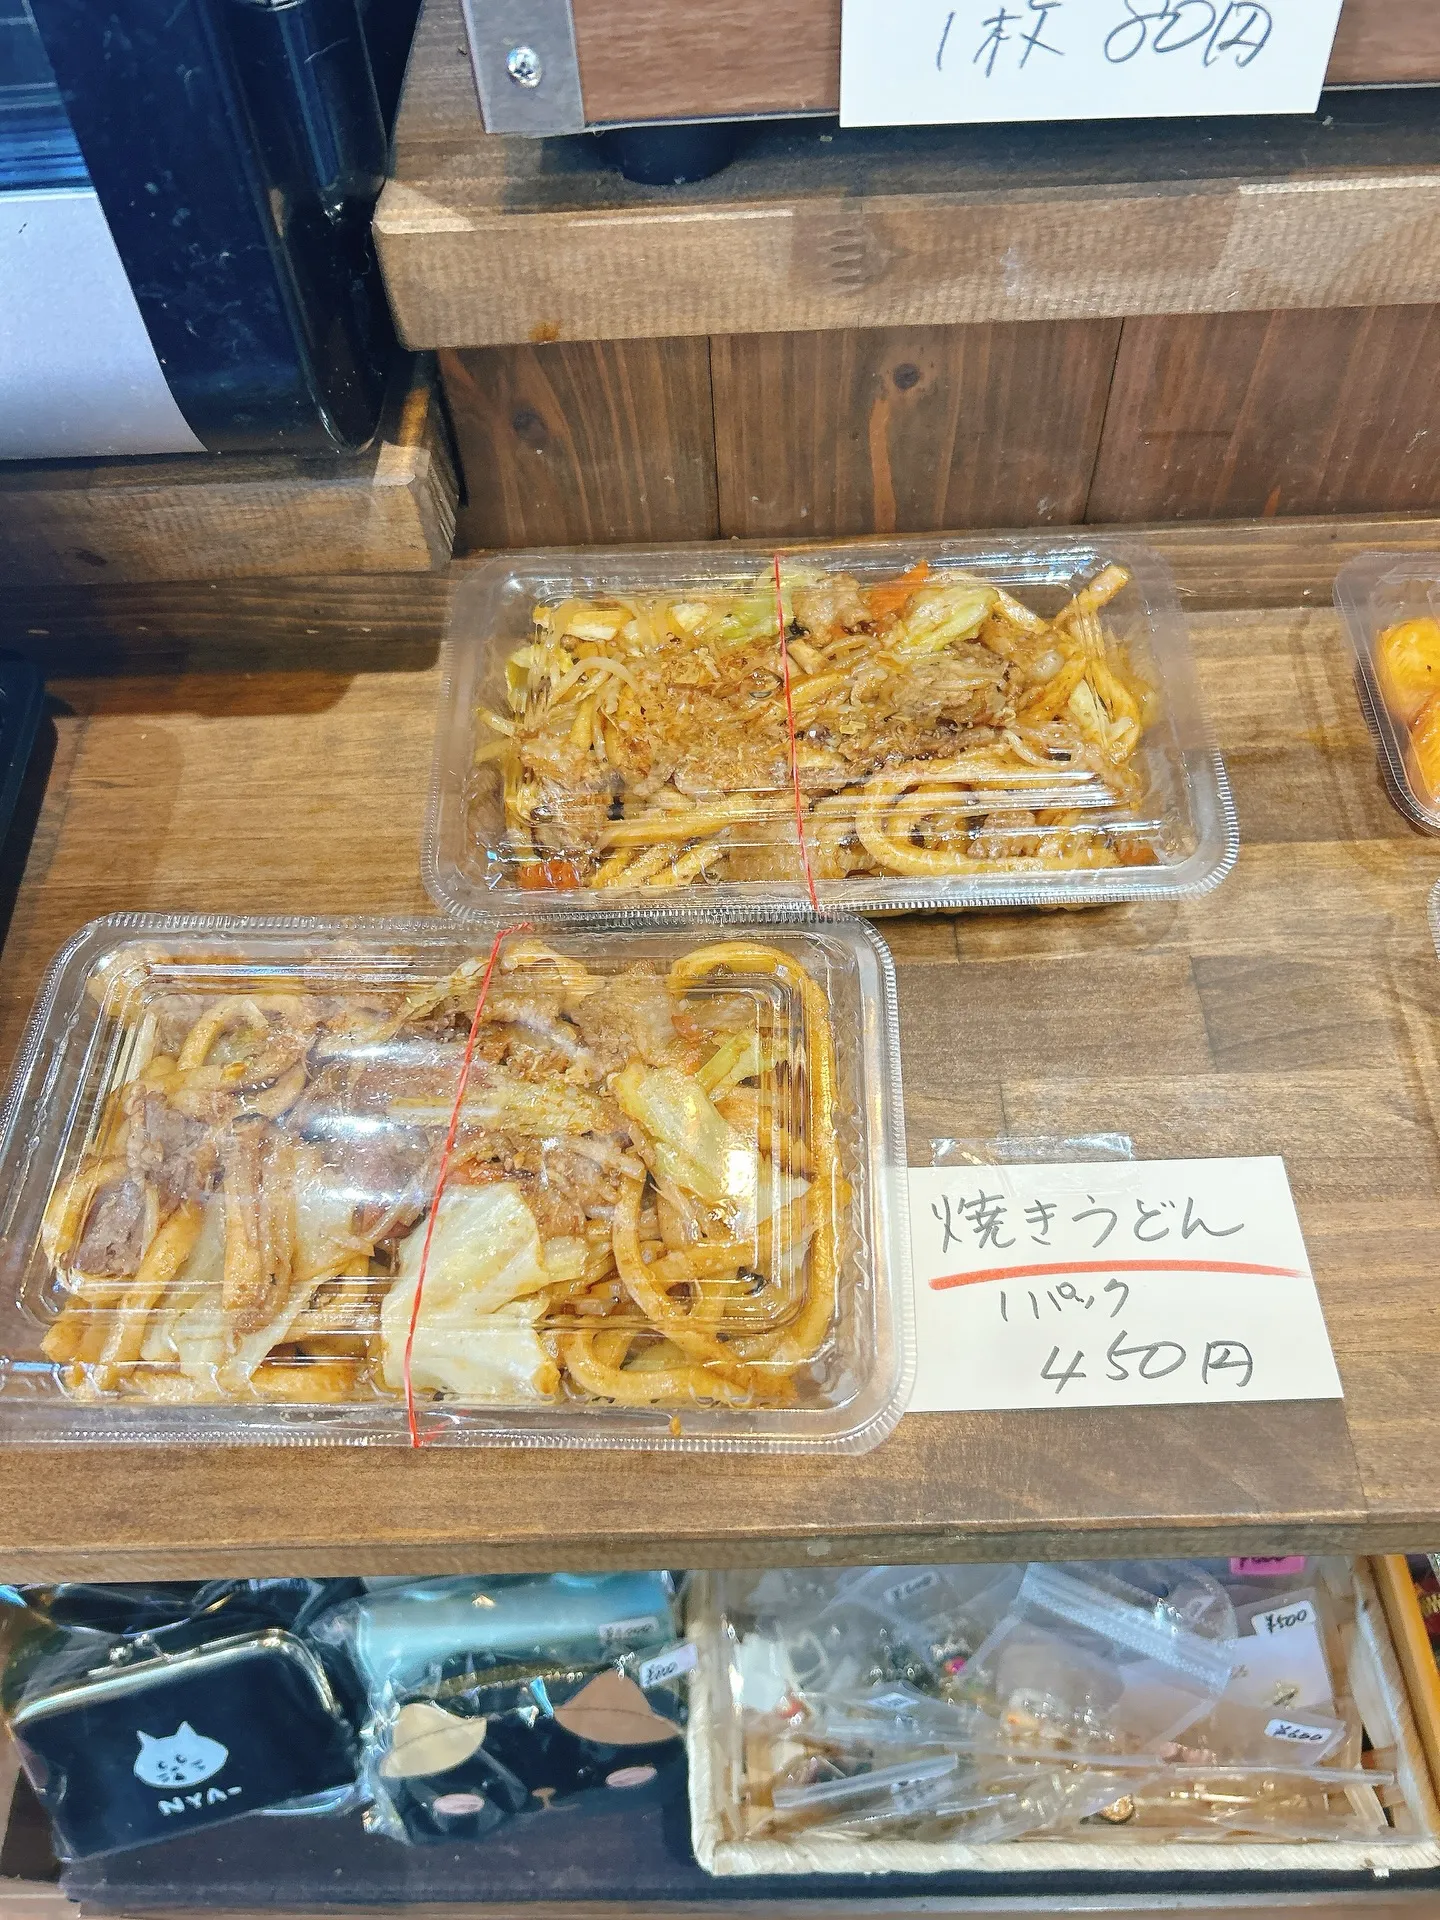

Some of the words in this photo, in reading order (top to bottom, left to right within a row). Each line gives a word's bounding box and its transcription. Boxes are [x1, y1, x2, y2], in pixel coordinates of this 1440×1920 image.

[931, 1189, 1245, 1253] 焼きうどん
[1000, 1279, 1129, 1322] 1パック
[1041, 1330, 1254, 1394] 450円
